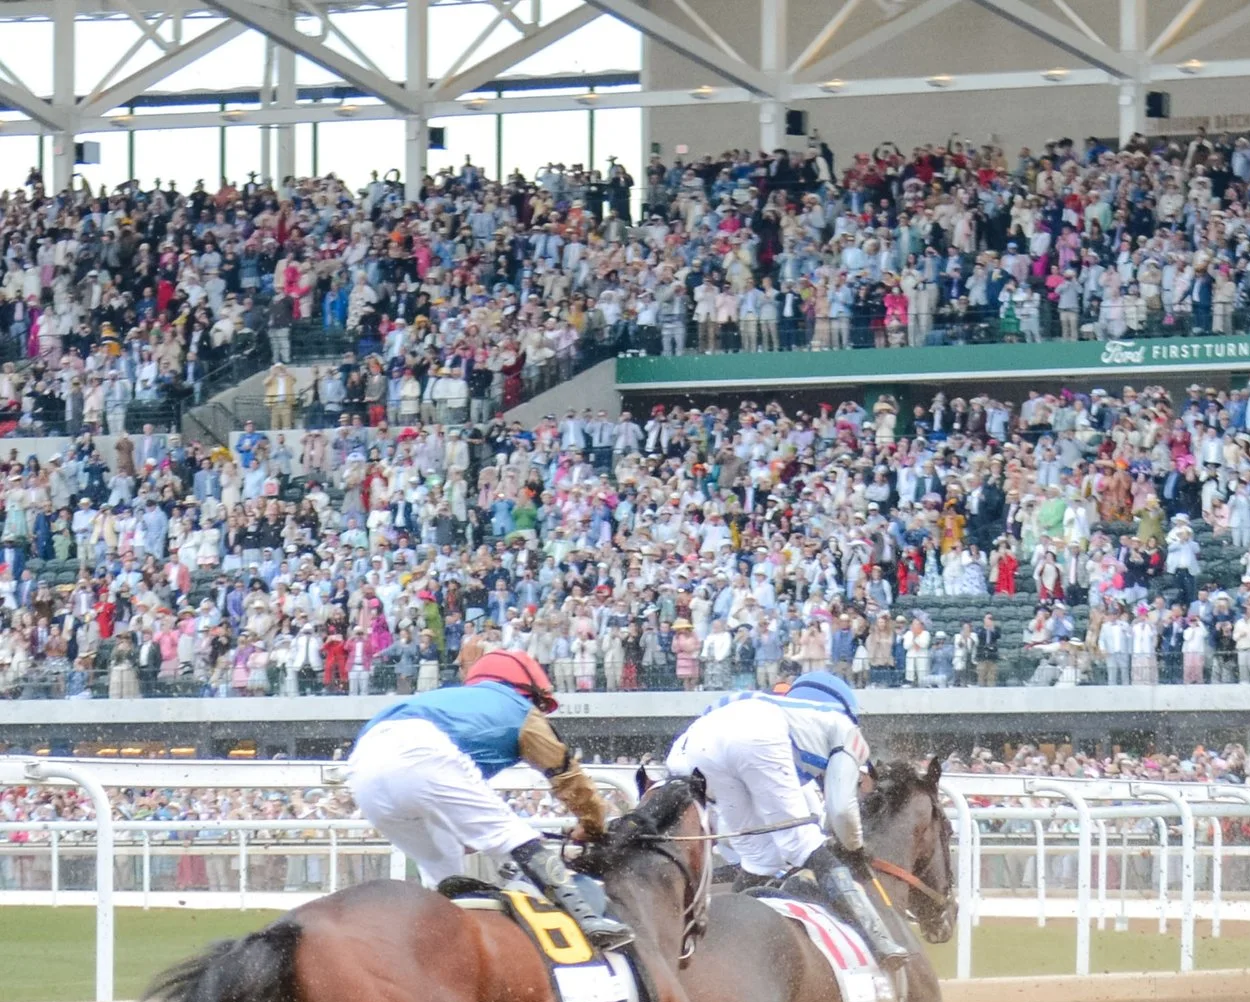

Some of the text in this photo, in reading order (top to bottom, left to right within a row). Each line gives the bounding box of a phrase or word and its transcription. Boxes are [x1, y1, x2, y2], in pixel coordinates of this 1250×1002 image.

[1101, 340, 1146, 364] Ford
[1152, 344, 1200, 359] FIRST
[1203, 342, 1249, 358] TURN
[559, 704, 590, 714] CLUB
[502, 890, 594, 964] 6
